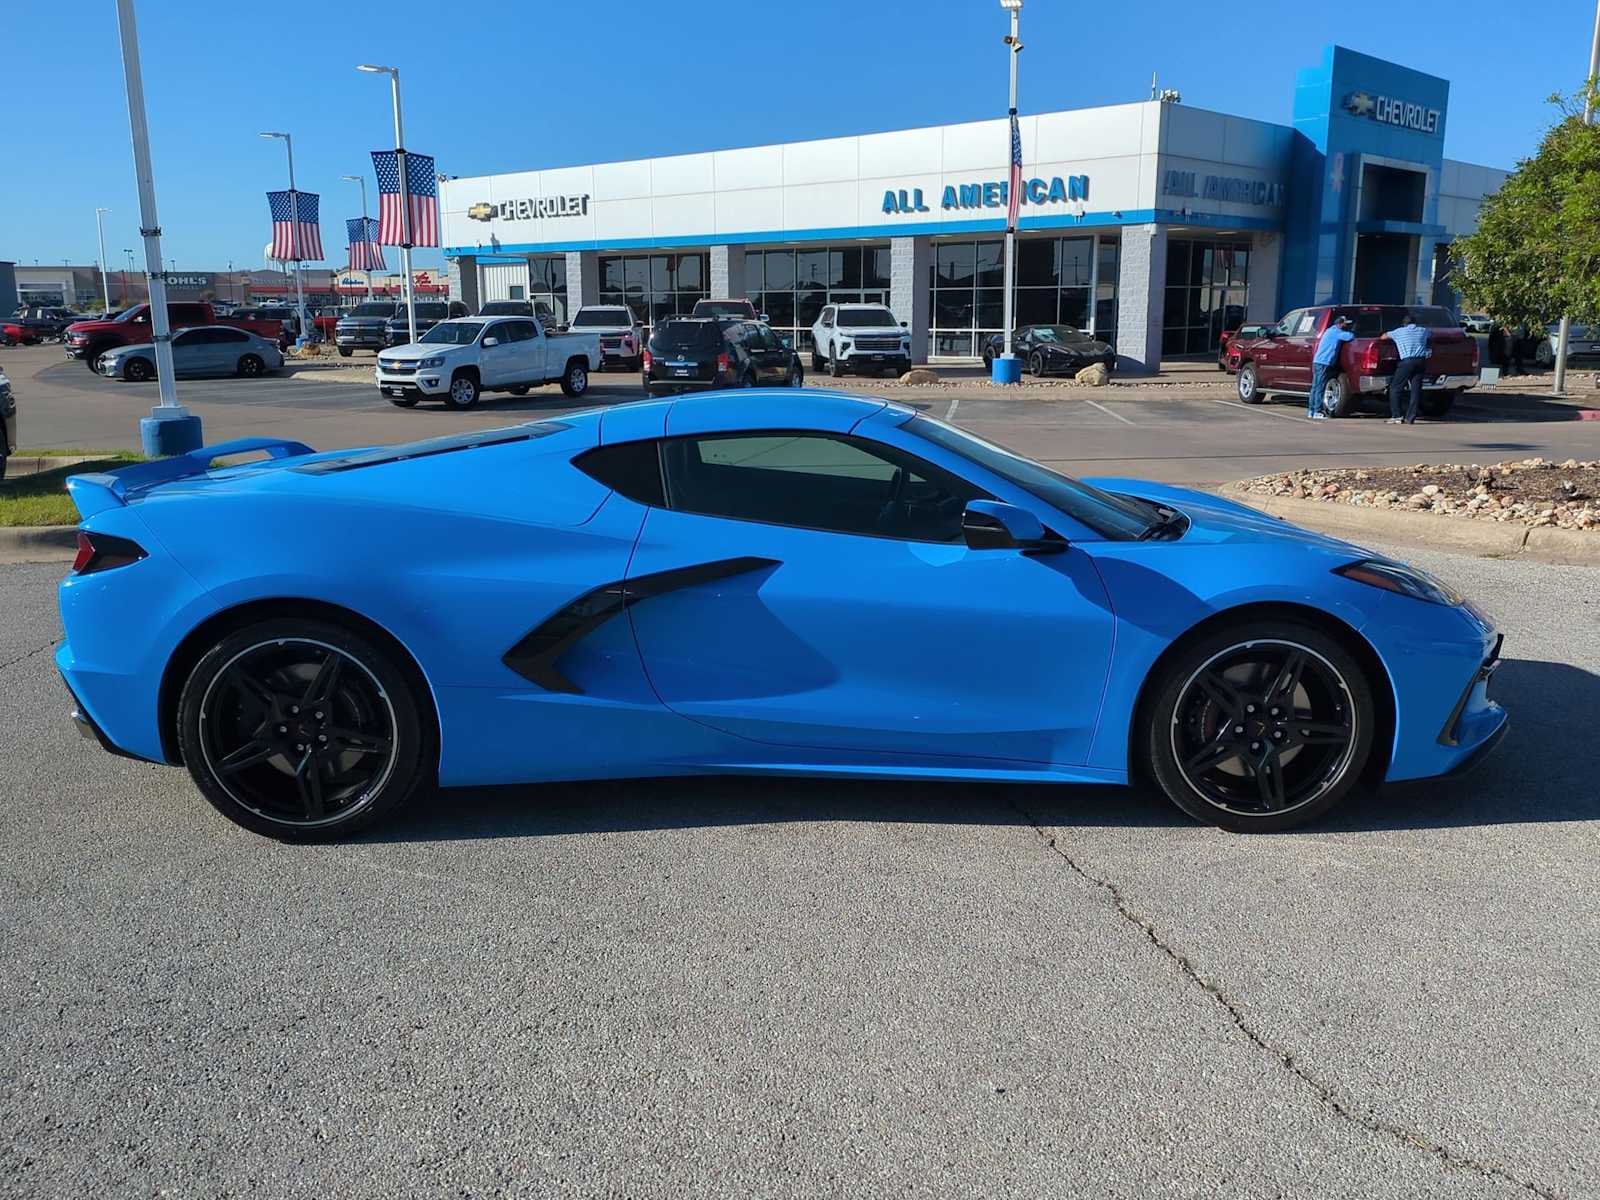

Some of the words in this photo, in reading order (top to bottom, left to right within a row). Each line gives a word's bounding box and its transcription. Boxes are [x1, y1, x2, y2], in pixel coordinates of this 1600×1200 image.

[1376, 96, 1440, 133] CHEVROLET
[499, 194, 590, 221] CHEVROLET
[882, 188, 929, 214] ALL
